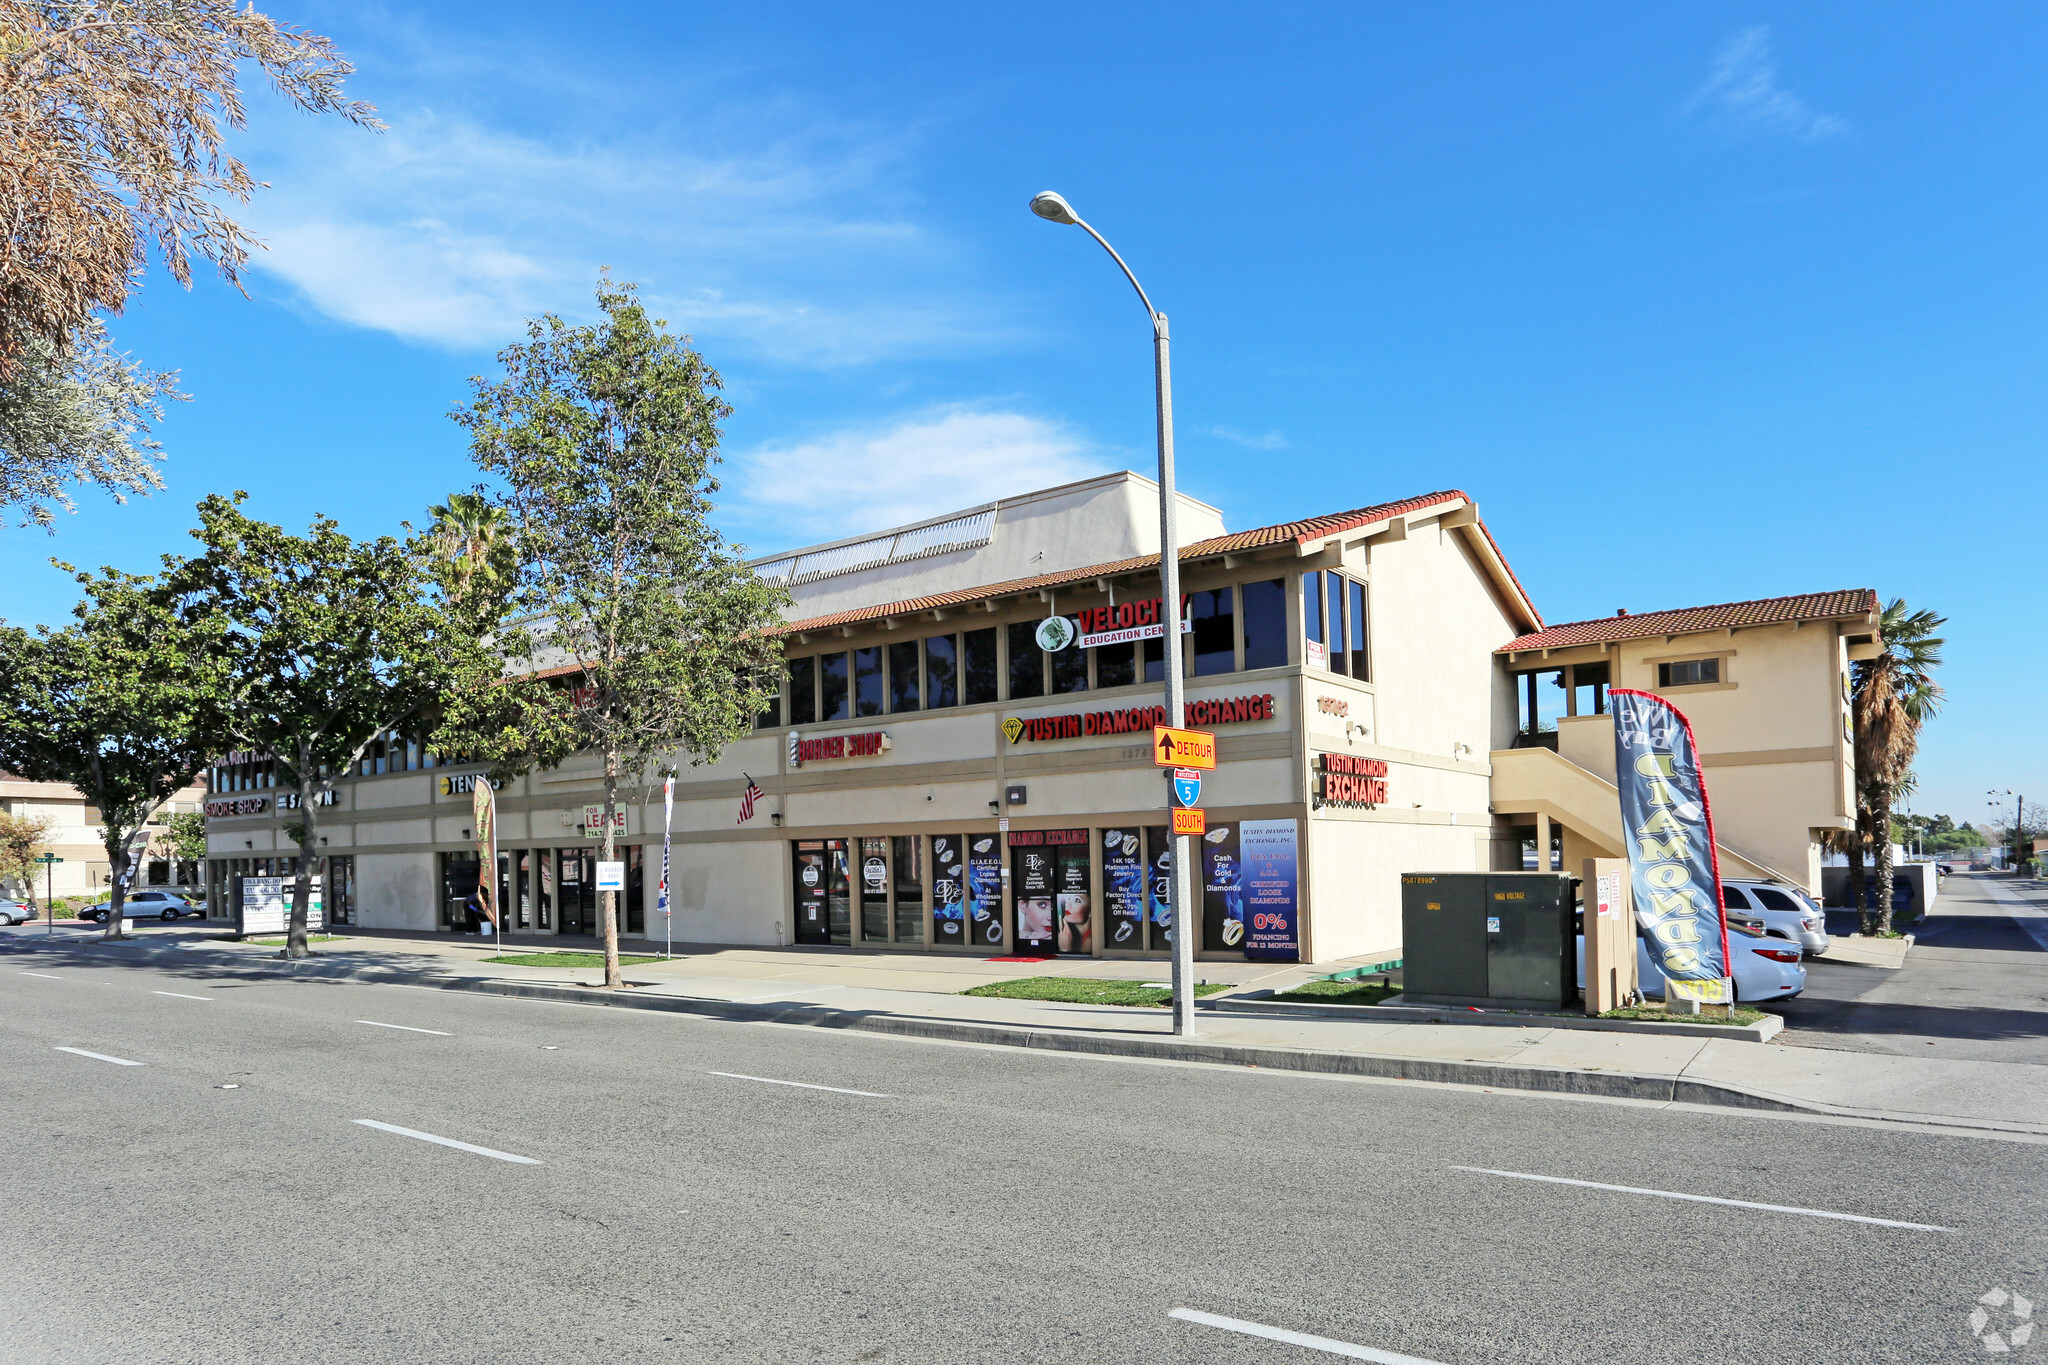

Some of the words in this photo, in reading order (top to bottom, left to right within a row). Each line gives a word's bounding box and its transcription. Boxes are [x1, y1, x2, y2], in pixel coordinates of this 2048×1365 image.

[1084, 629, 1141, 646] EDUCATION
[1144, 623, 1186, 637] CENR
[1318, 695, 1348, 716] 13762
[1024, 713, 1081, 741] TUSTIN
[1085, 705, 1167, 735] DIAMOND
[1182, 694, 1273, 726] XCHANGE
[799, 736, 845, 761] BARBER
[849, 732, 882, 756] SHOP
[1177, 741, 1212, 758] DETOUR
[1326, 753, 1352, 774] TUSTIN
[1354, 757, 1388, 778] DIAMOND
[1185, 786, 1191, 801] 5
[1326, 775, 1388, 804] EXCHANGE
[206, 802, 234, 816] SMOKE
[238, 799, 262, 814] SHOP
[1177, 814, 1202, 828] SOUTH
[1008, 832, 1043, 846] DIAMOND
[1046, 830, 1088, 845] EXCHANGE
[1215, 869, 1231, 877] Gold
[1254, 913, 1287, 930] 0%
